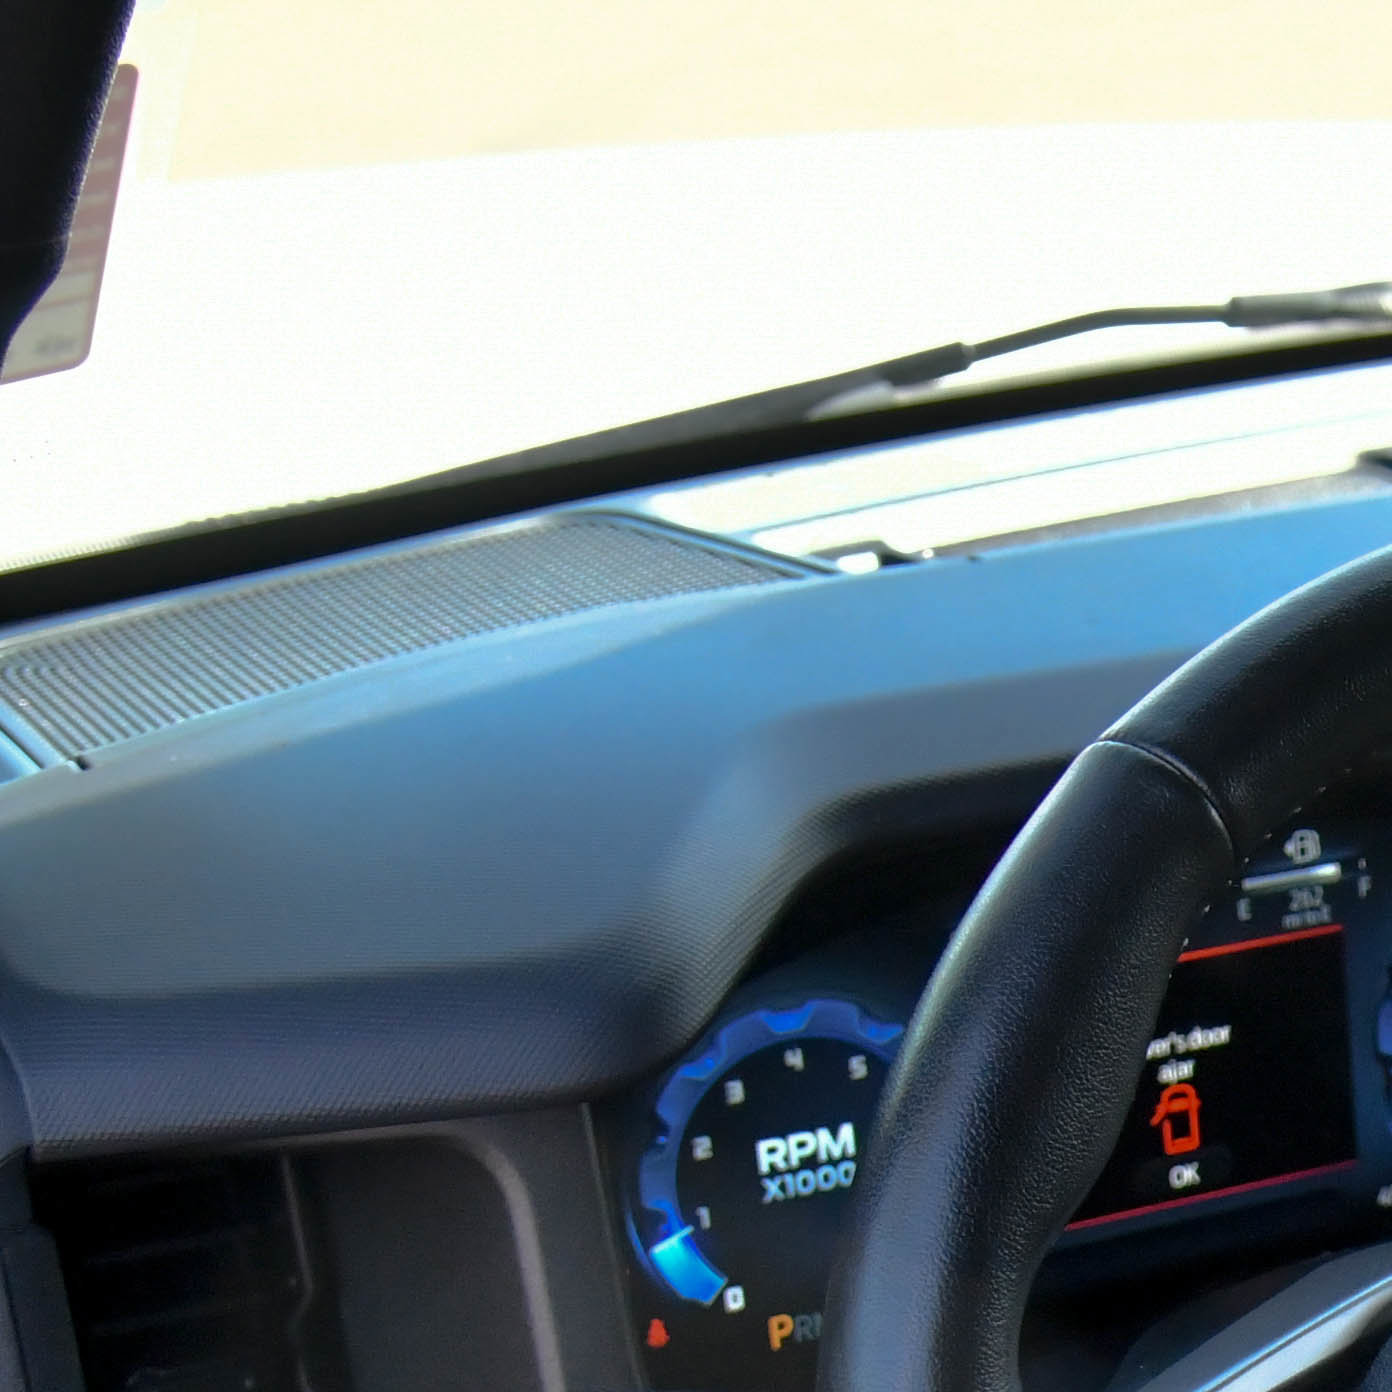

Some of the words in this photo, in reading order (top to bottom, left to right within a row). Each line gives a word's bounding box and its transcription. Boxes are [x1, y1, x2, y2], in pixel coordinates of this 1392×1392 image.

[783, 1047, 805, 1072] 4
[848, 1054, 869, 1081] 5
[1157, 1058, 1197, 1086] ajar
[723, 1079, 746, 1106] 3
[691, 1134, 714, 1162] 2
[755, 1122, 858, 1177] RPM
[1168, 1161, 1201, 1190] OK
[695, 1205, 712, 1230] 1
[722, 1285, 747, 1314] 0
